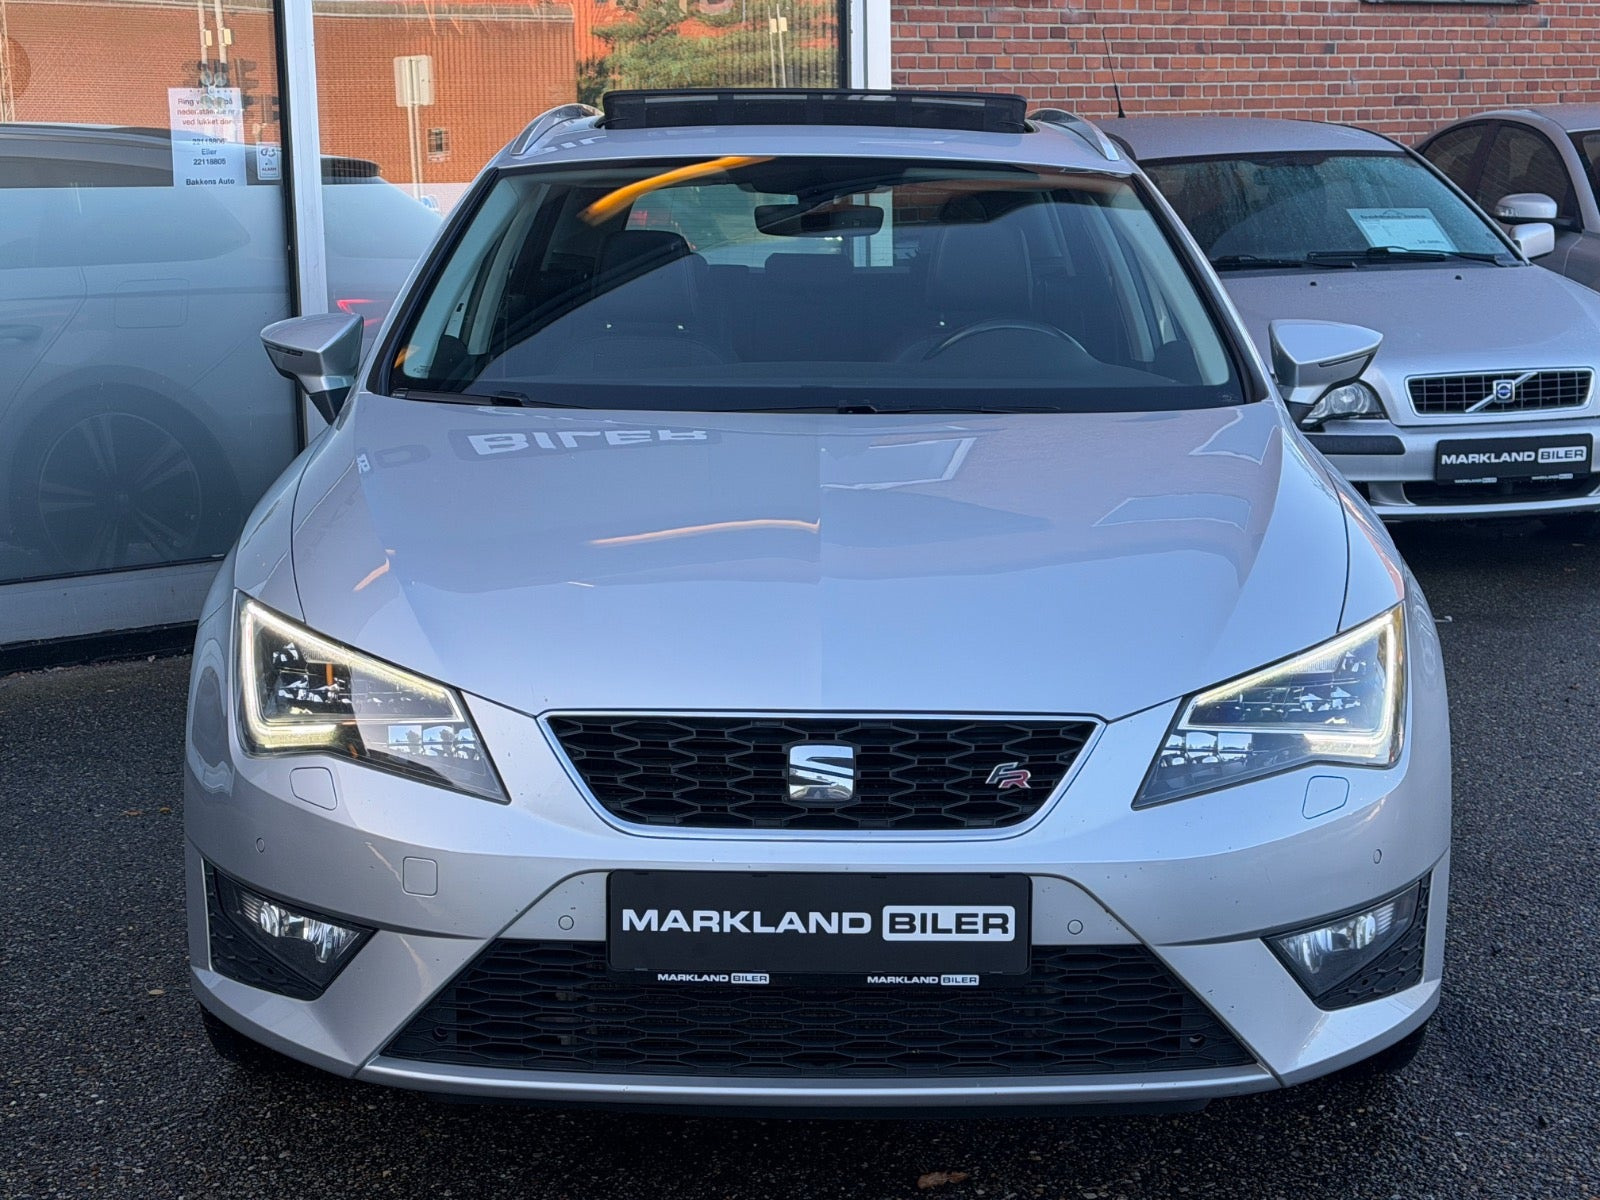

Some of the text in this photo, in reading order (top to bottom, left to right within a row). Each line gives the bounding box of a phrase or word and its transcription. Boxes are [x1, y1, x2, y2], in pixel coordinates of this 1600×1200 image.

[186, 178, 217, 186] Bakkens
[1441, 449, 1585, 465] MARKLAND BILER
[985, 761, 1032, 789] FR
[622, 909, 1010, 935] MARKLAND BILER
[657, 973, 768, 983] MARKLAND BILER
[867, 975, 977, 984] MARKLAND BILER
